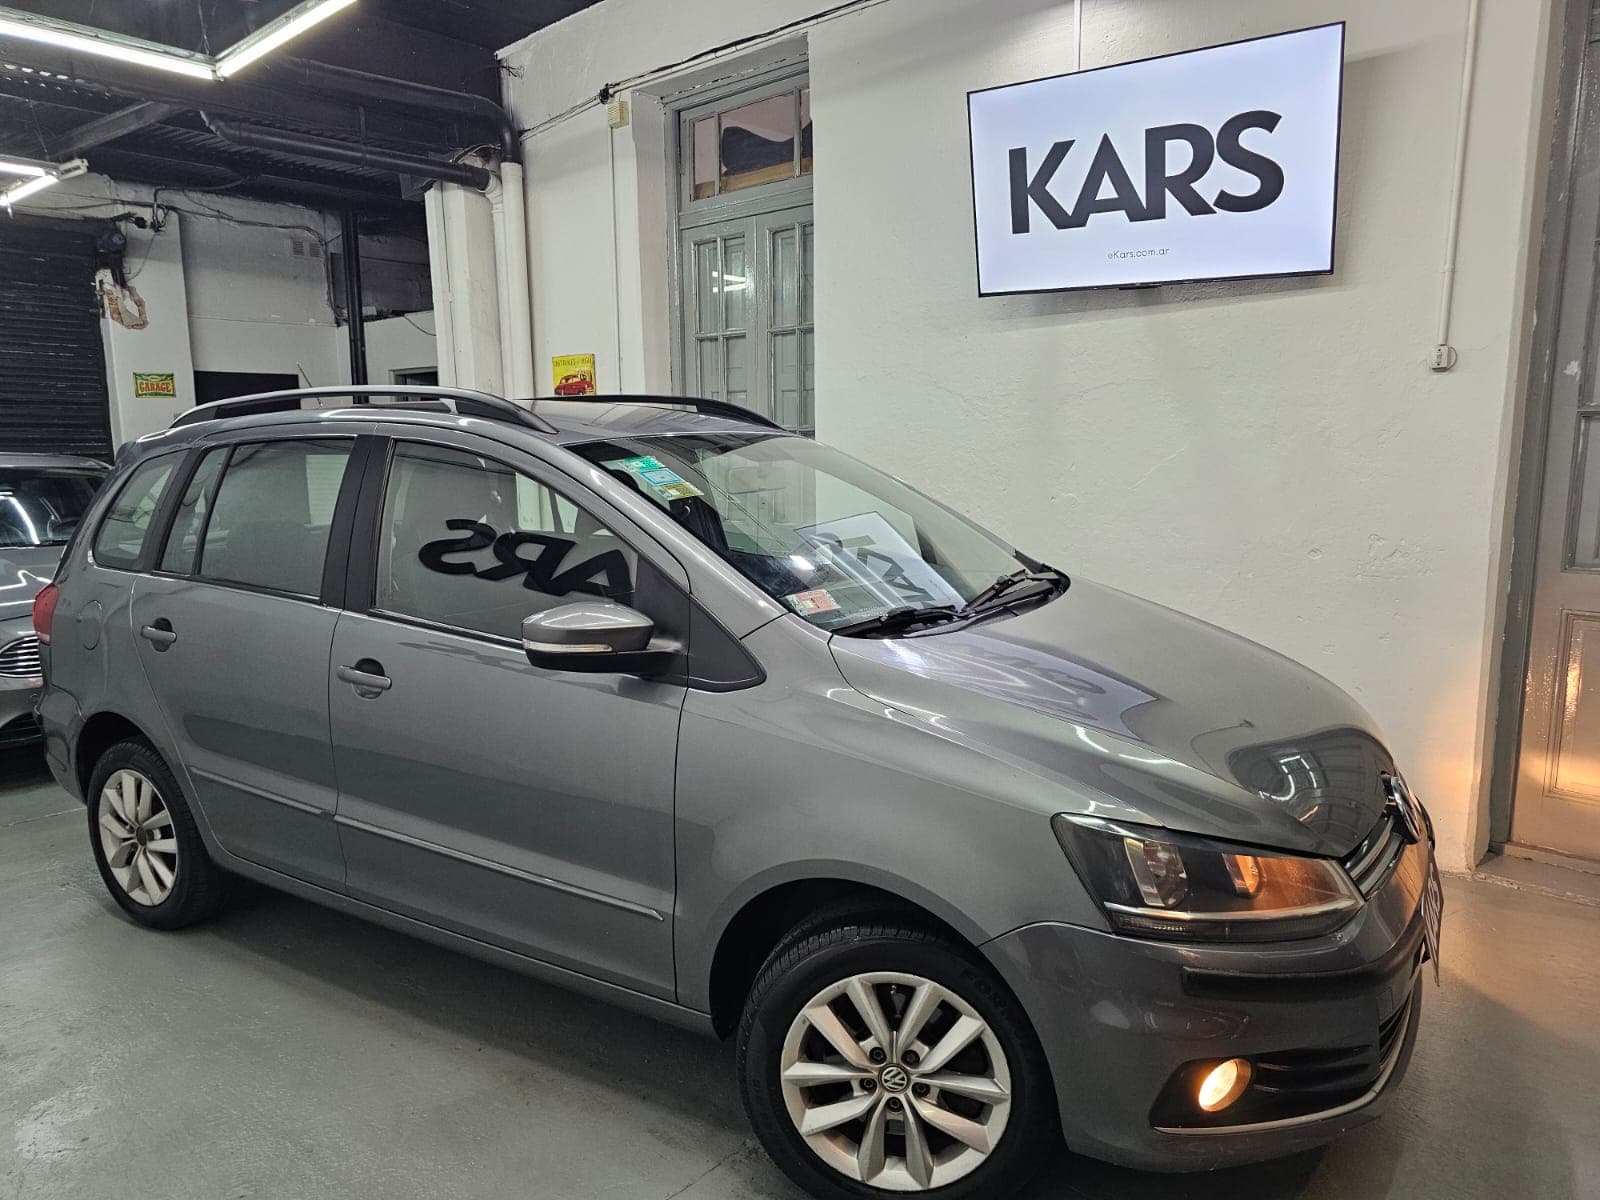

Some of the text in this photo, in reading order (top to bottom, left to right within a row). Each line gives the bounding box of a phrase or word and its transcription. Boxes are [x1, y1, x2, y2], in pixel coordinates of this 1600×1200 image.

[1008, 110, 1285, 235] KARS
[1107, 248, 1170, 260] eKars.com.ar
[139, 381, 172, 393] GARAGE
